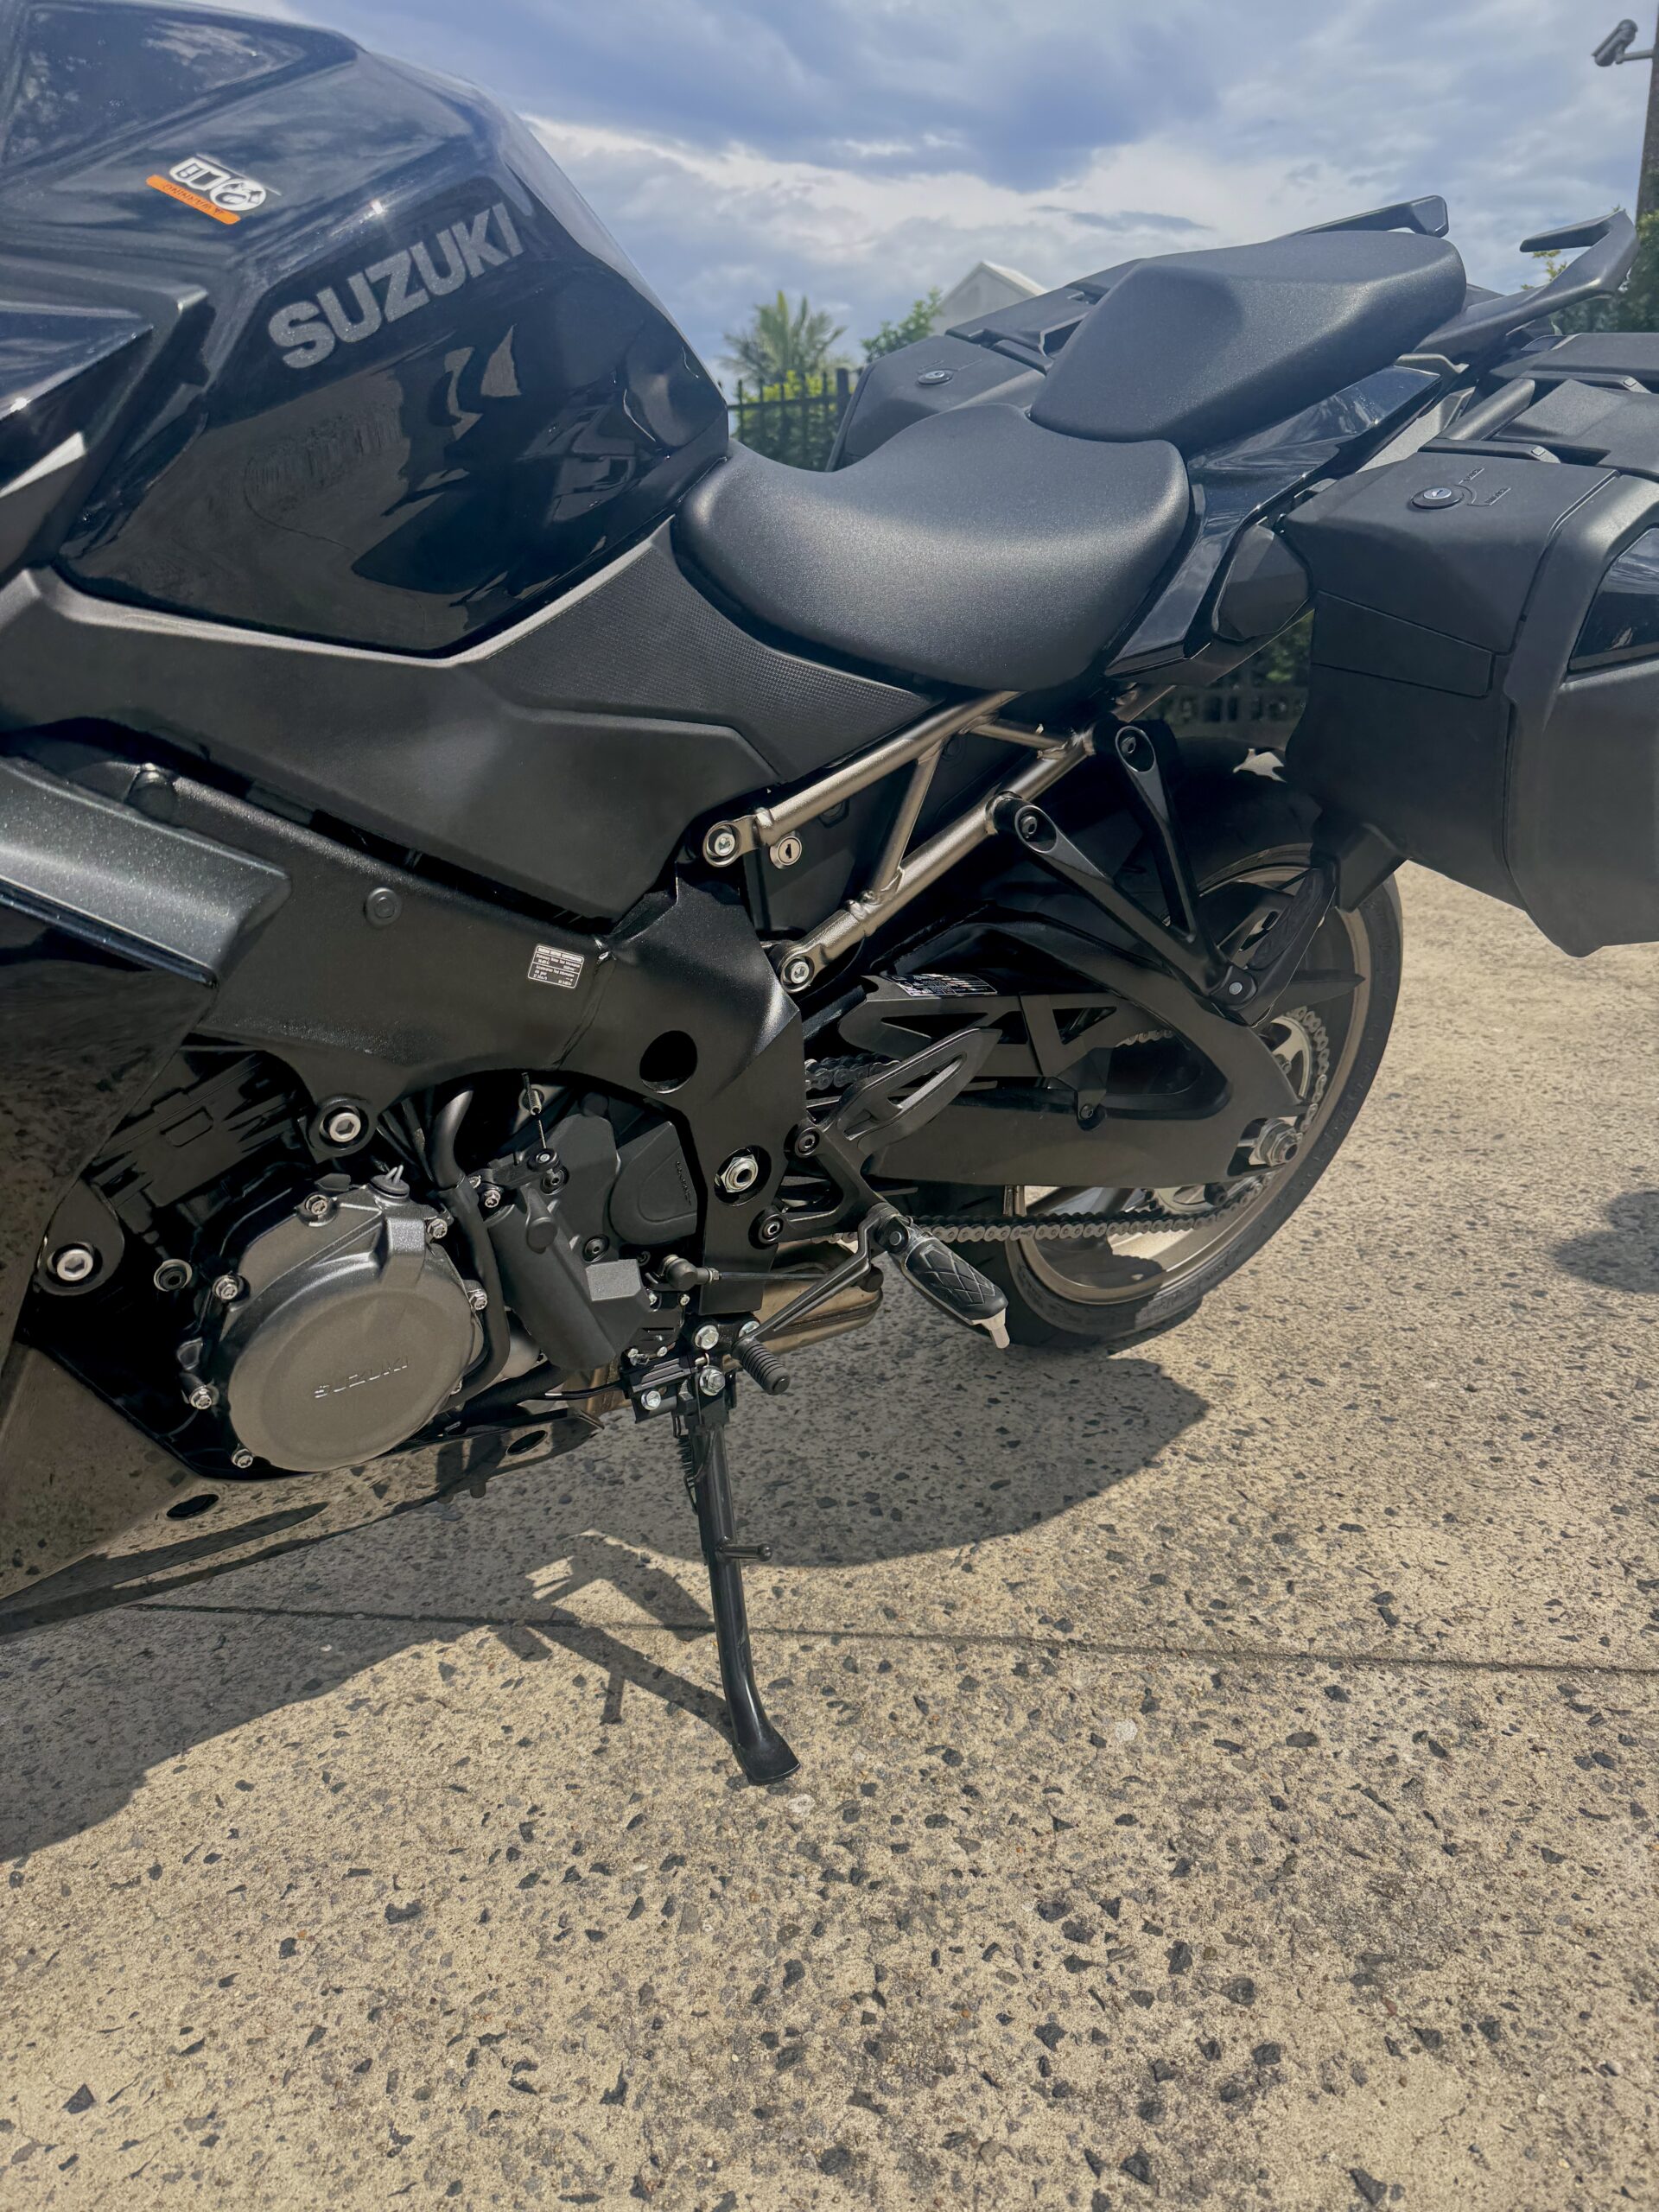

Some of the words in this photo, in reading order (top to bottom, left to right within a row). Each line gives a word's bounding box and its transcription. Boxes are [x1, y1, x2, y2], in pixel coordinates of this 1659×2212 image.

[162, 183, 213, 210] WARNING
[268, 202, 524, 369] SUZUKI
[314, 1355, 409, 1399] SUZUKI
